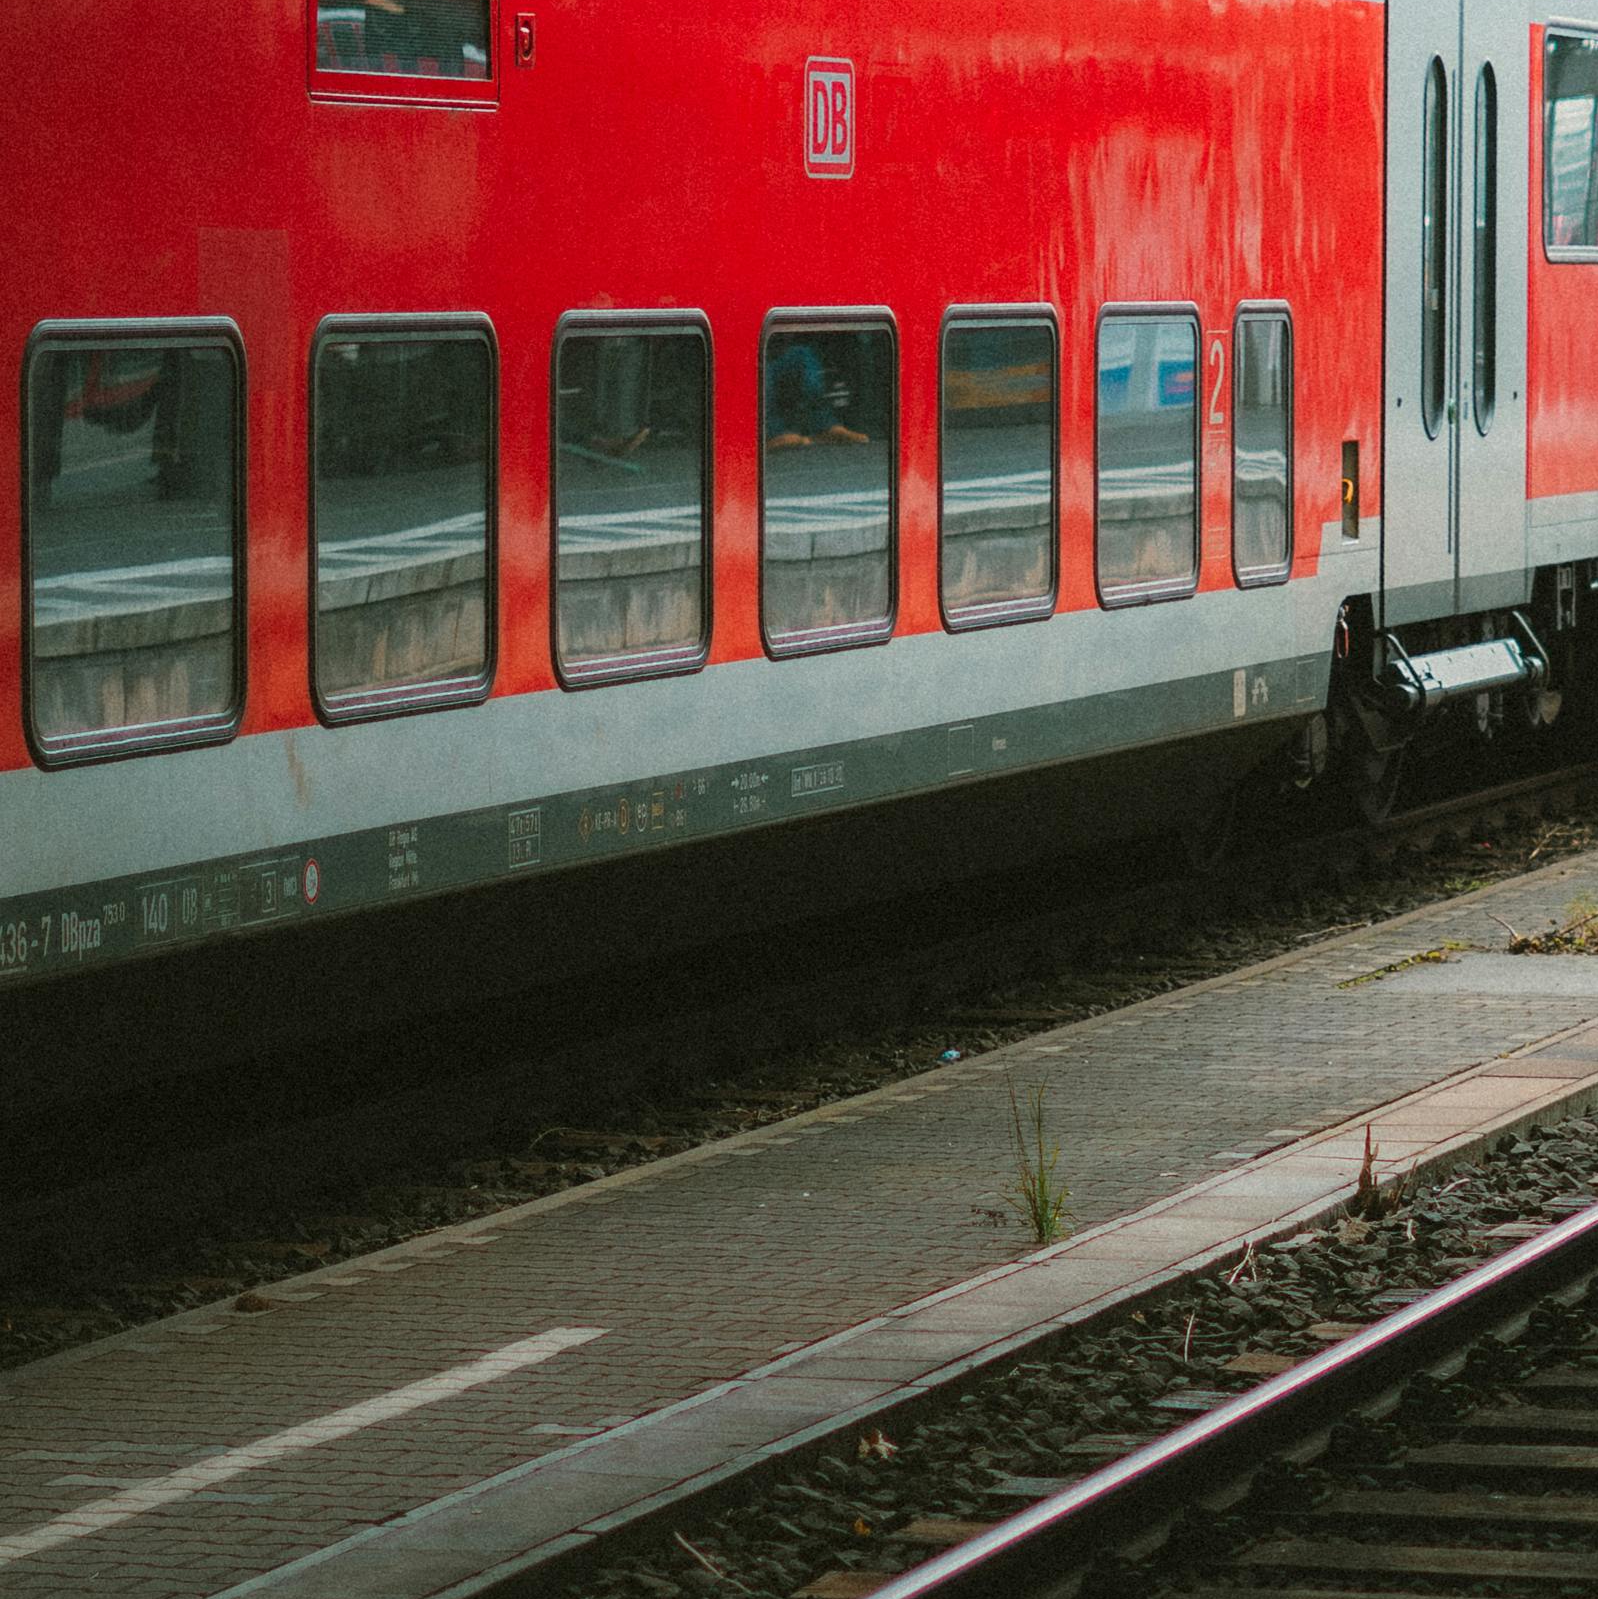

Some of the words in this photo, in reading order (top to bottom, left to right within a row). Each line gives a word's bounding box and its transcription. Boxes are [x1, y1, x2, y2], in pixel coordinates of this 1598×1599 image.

[812, 79, 848, 155] DB
[1209, 338, 1224, 425] 2
[141, 893, 169, 935] 140
[181, 888, 198, 925] DB
[265, 879, 273, 904] 3
[61, 911, 101, 961] DBpza
